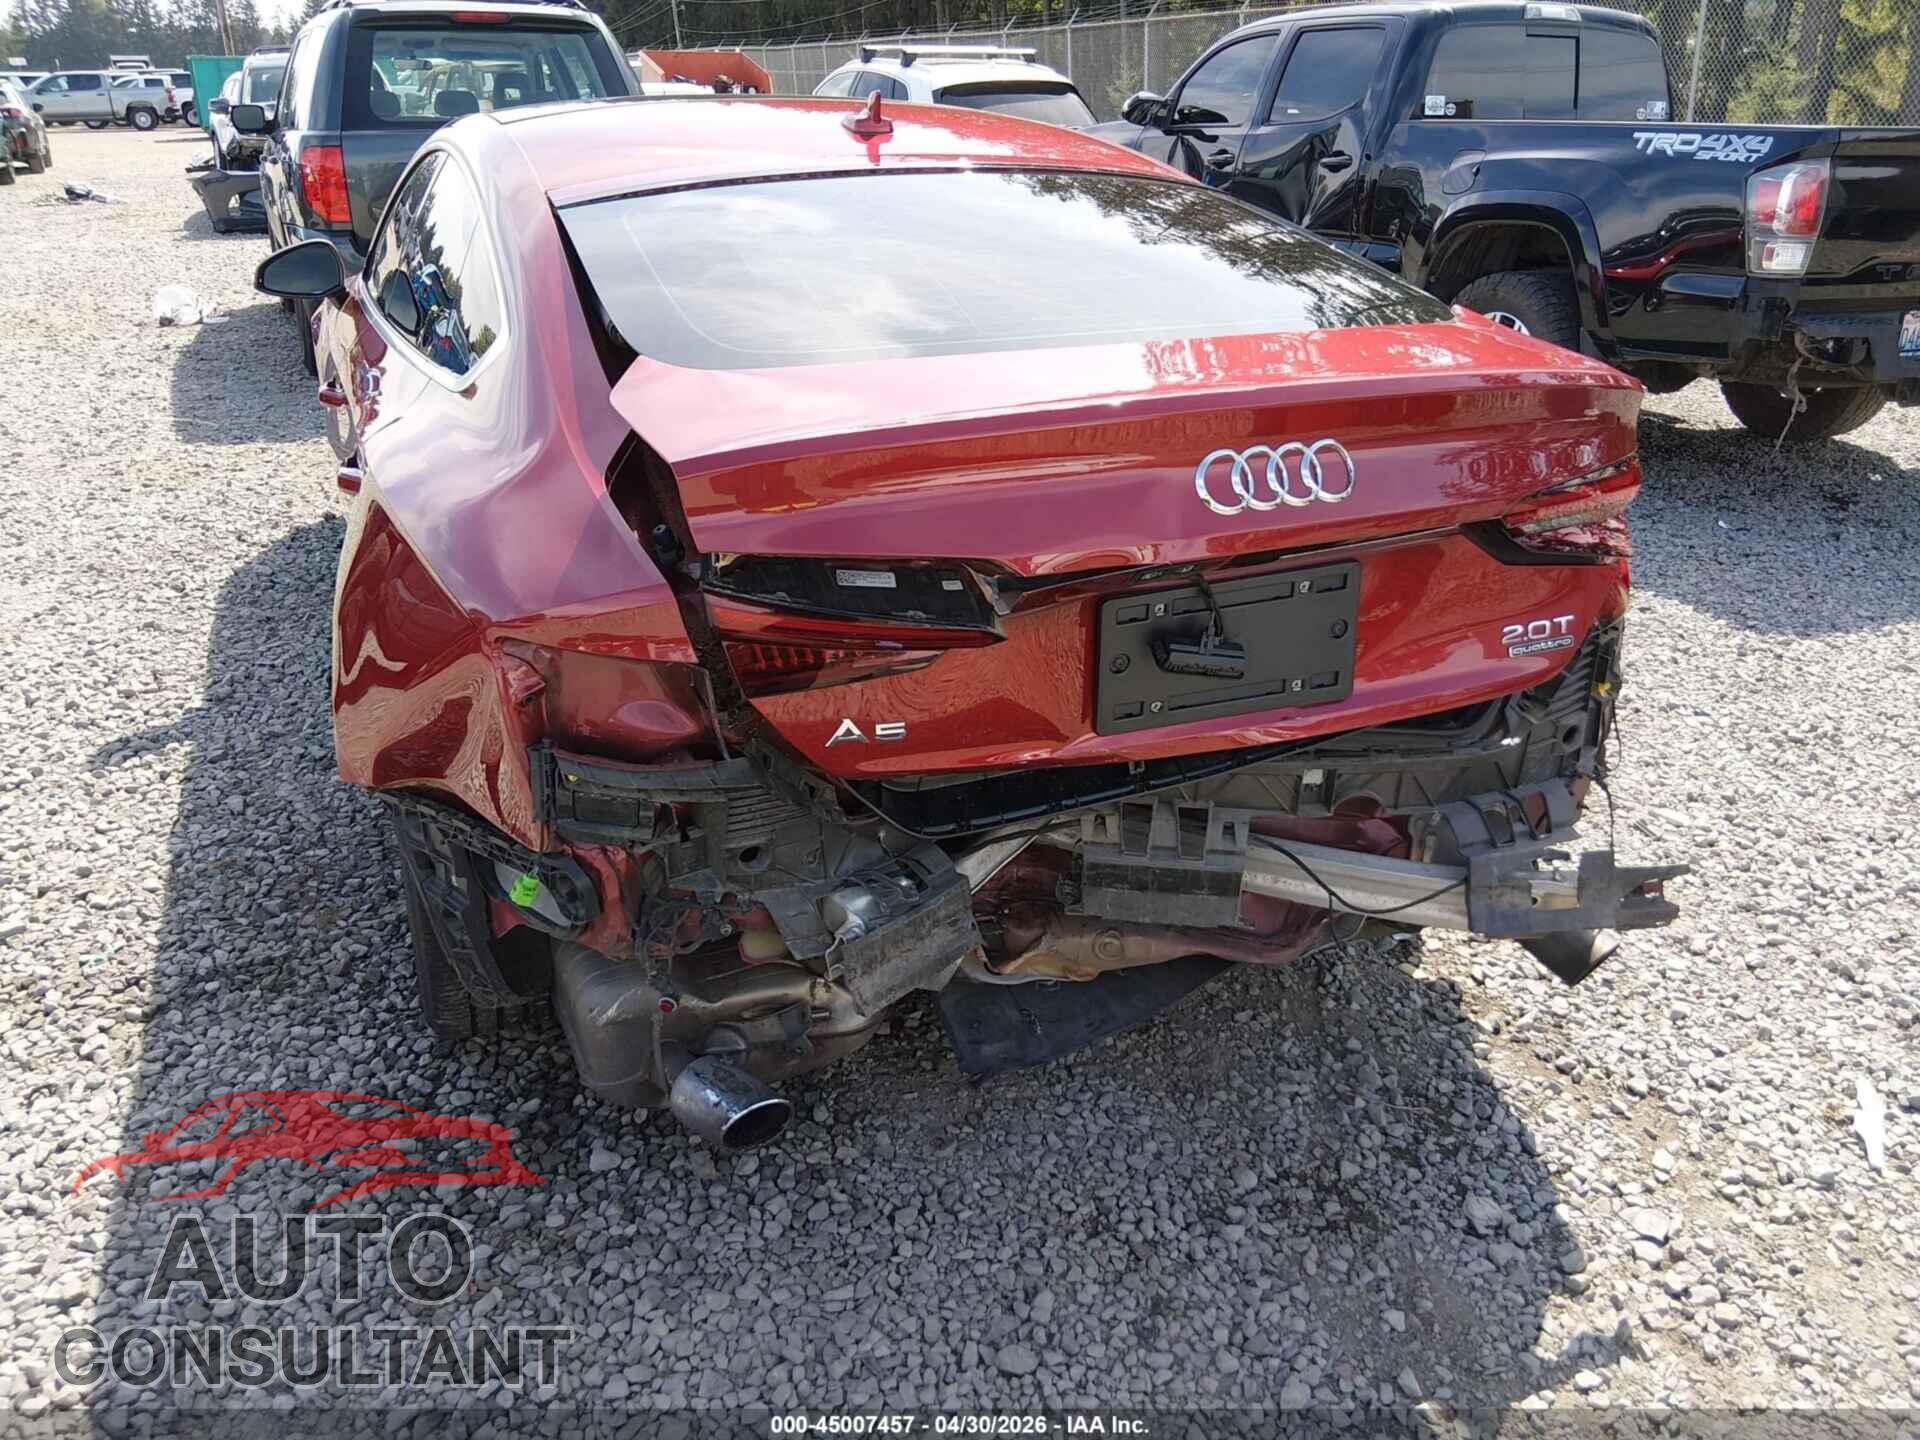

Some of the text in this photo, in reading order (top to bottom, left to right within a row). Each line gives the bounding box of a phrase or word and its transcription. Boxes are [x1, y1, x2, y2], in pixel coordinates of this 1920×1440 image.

[1633, 132, 1702, 157] TRD
[1693, 150, 1766, 163] SPORT
[1502, 615, 1574, 644] 2.0T
[1510, 636, 1573, 656] quattro
[825, 718, 907, 748] A5
